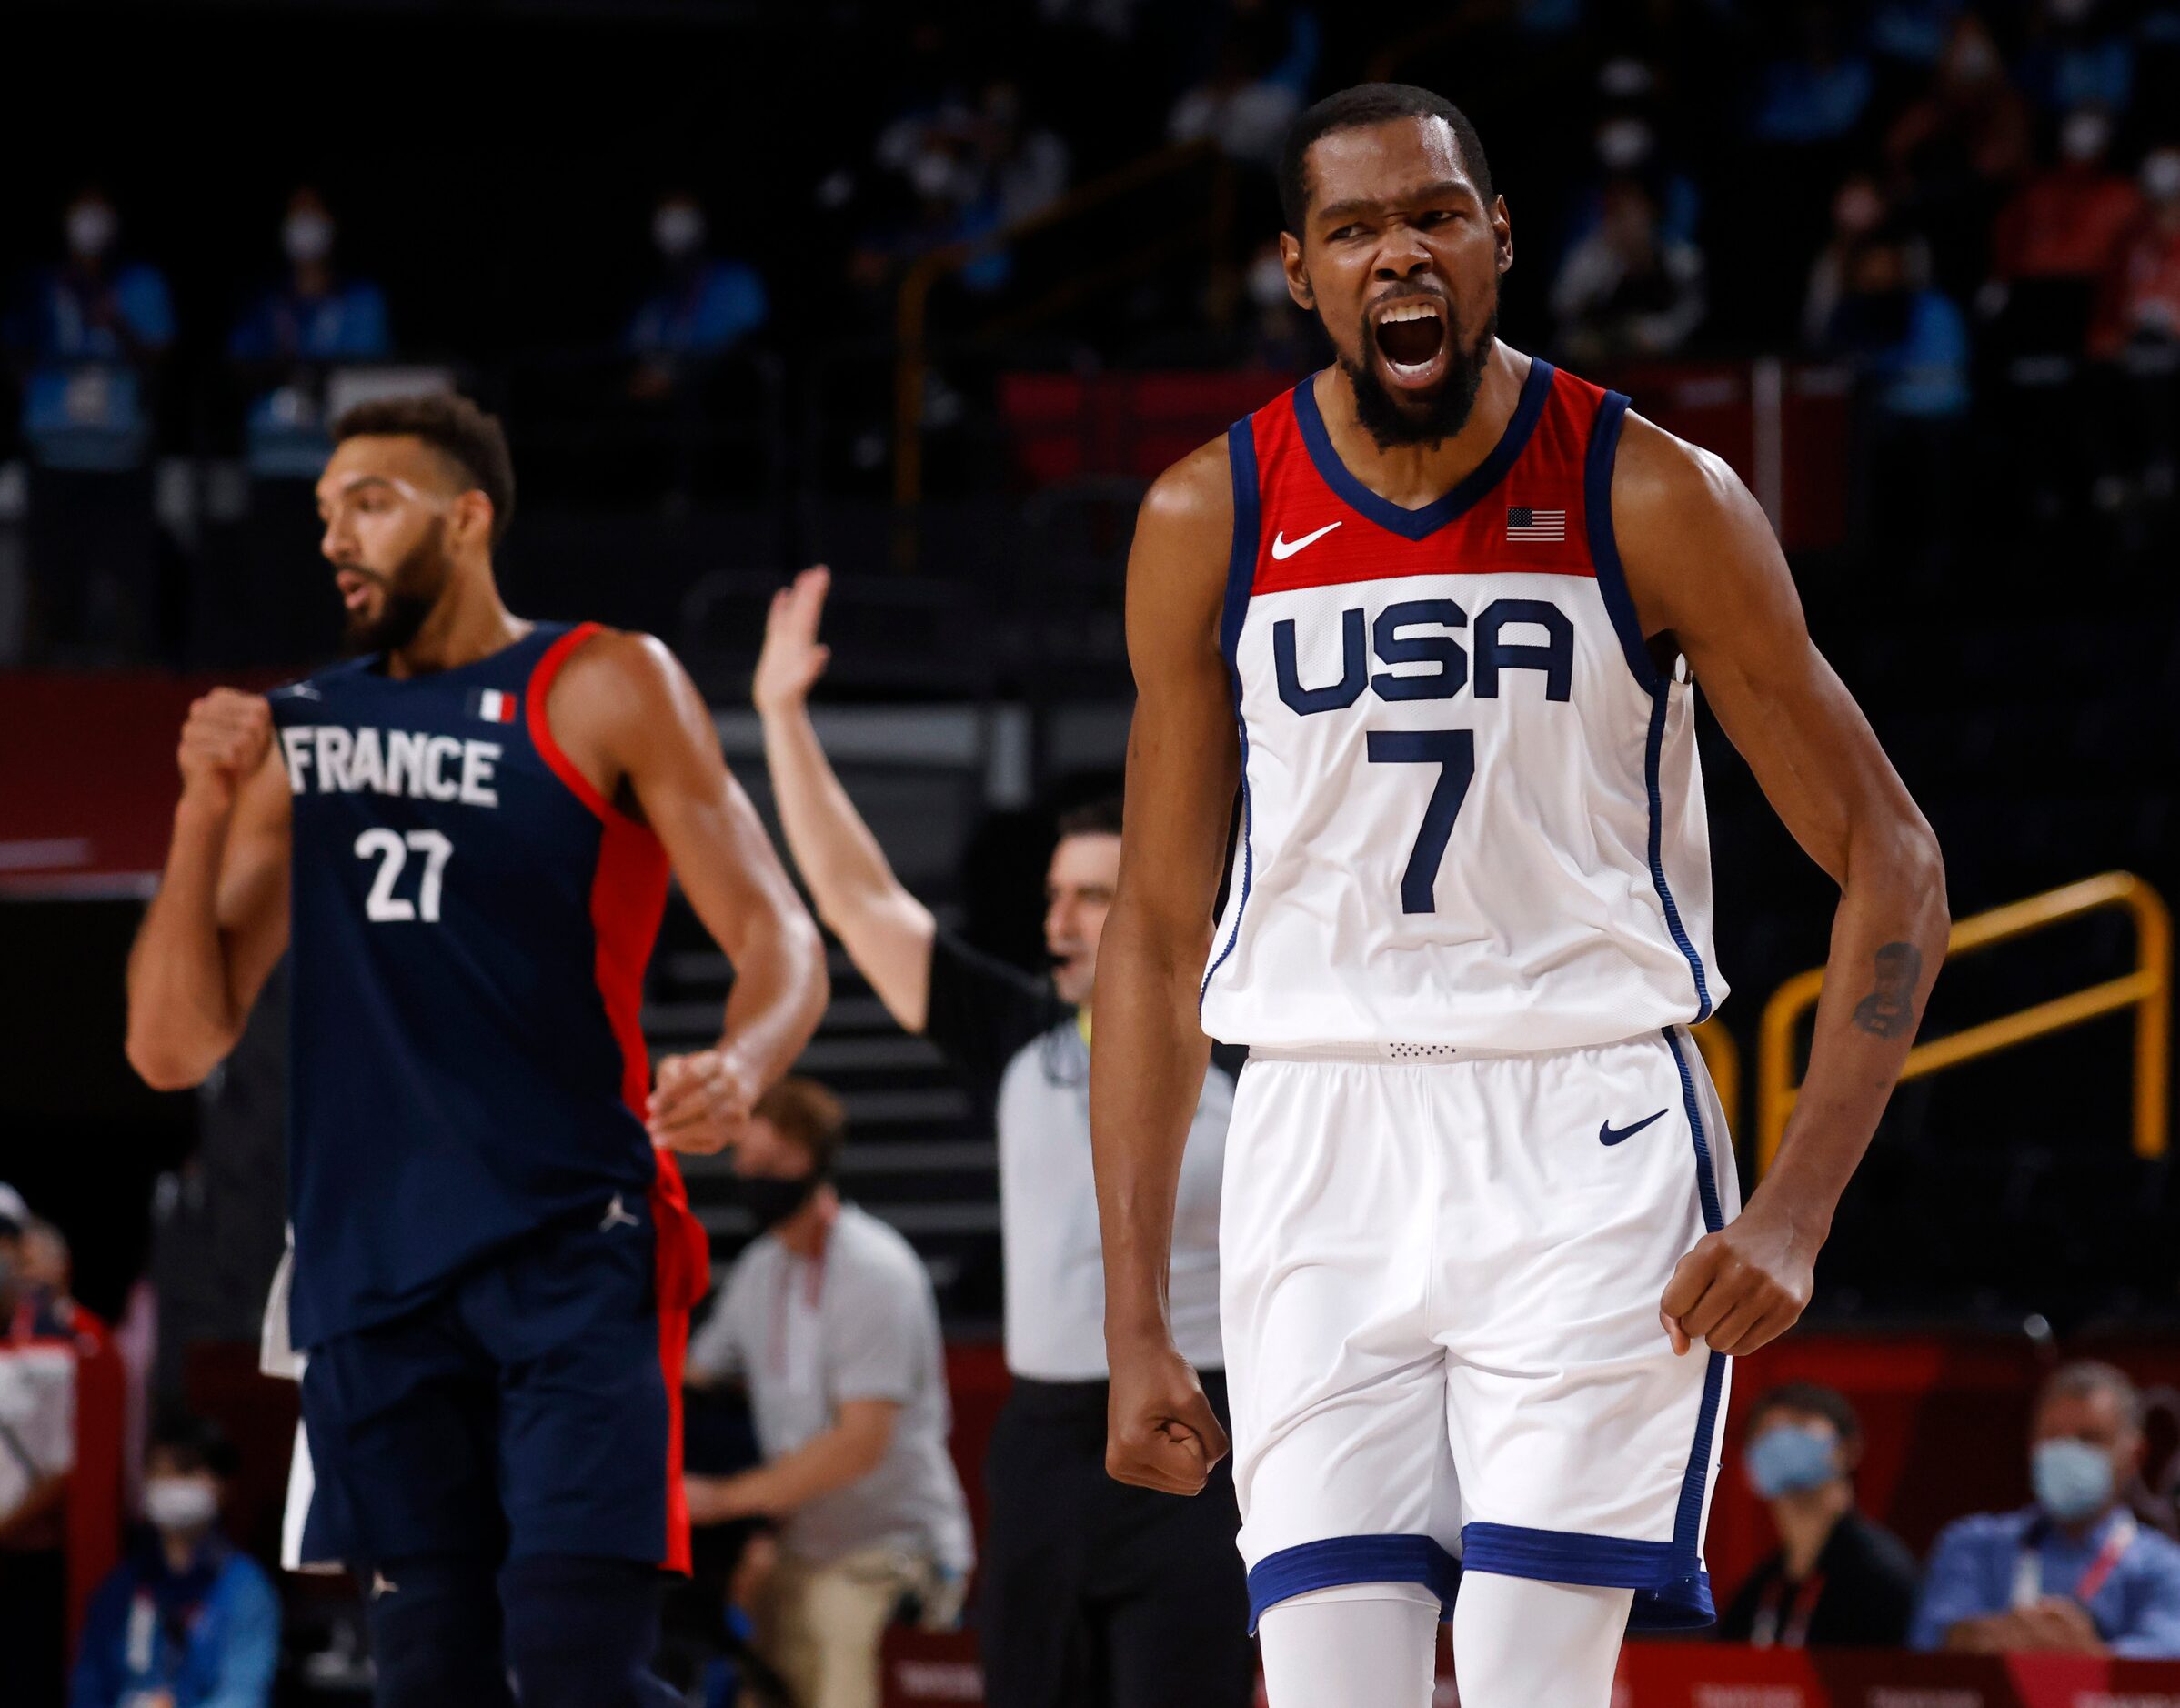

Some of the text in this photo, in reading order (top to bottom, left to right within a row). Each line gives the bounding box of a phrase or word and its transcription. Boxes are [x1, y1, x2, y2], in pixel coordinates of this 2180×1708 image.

[1273, 598, 1574, 716] USA
[282, 725, 502, 808] FRANCE
[1366, 729, 1474, 914] 7
[353, 828, 455, 923] 27
